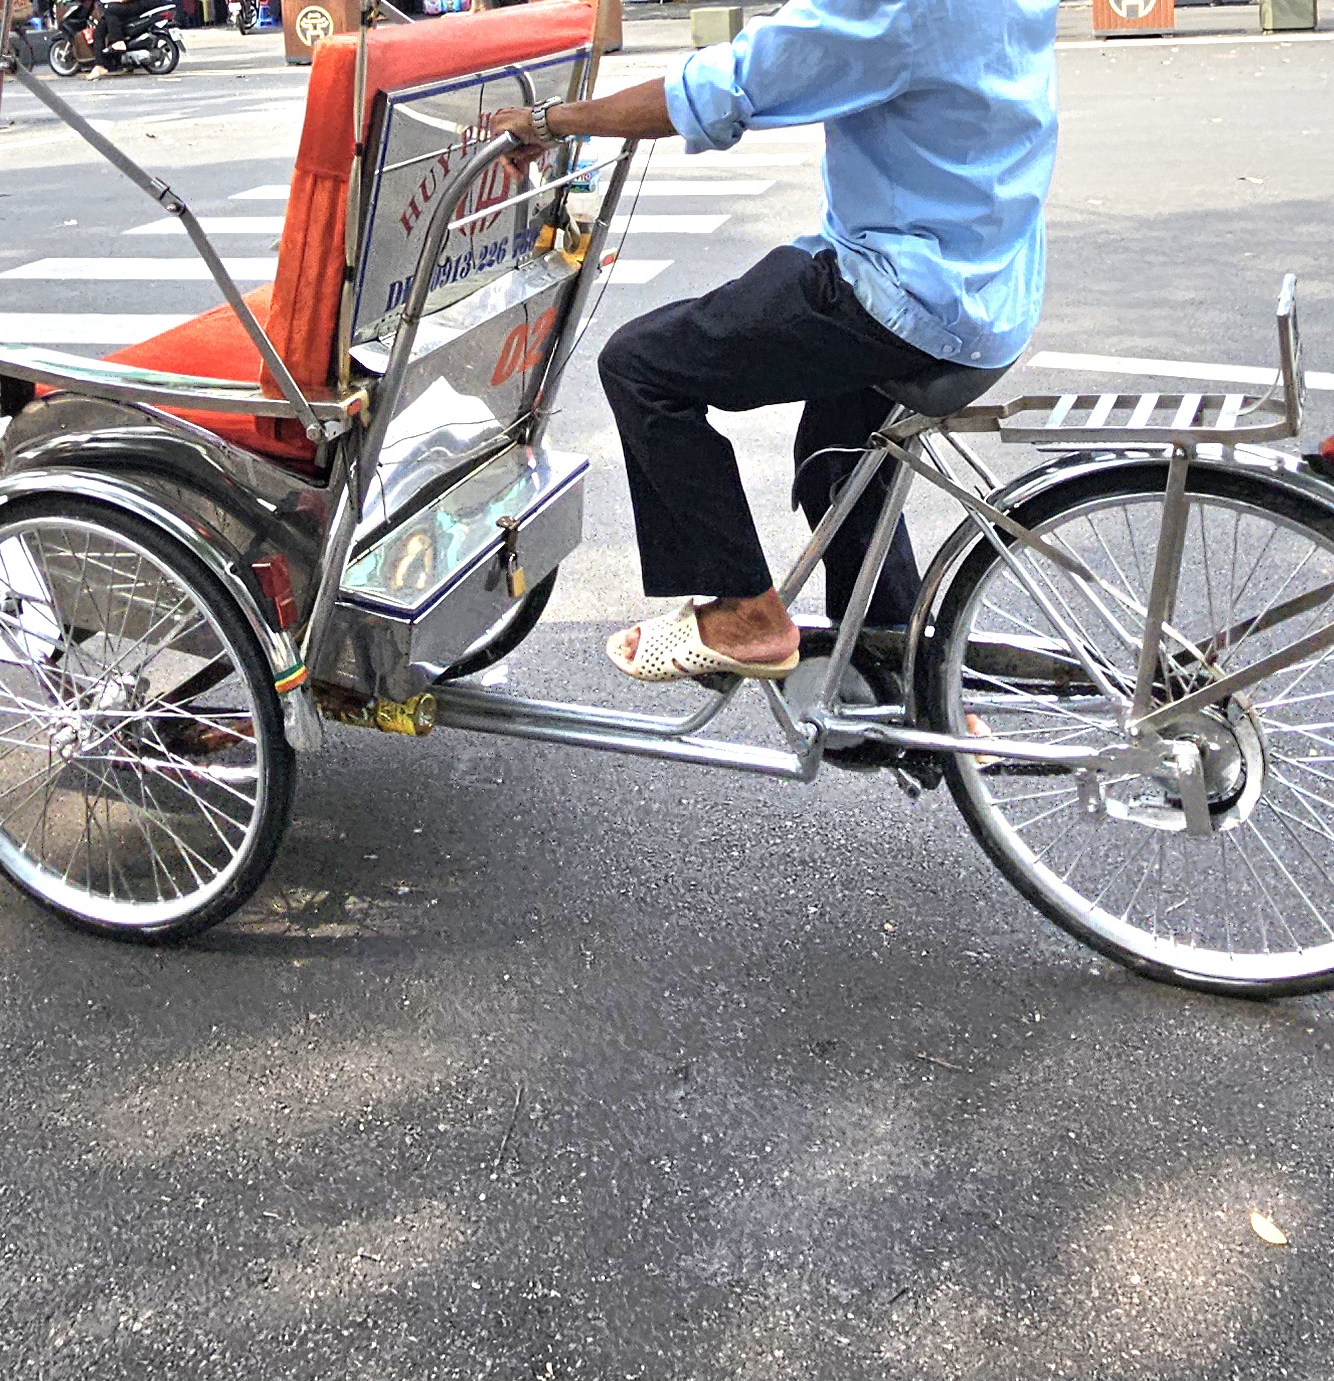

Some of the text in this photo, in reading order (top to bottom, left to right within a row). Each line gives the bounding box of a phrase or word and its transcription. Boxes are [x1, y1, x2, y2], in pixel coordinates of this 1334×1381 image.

[400, 143, 453, 239] HUY
[475, 235, 509, 274] 226
[490, 306, 558, 386] 02
